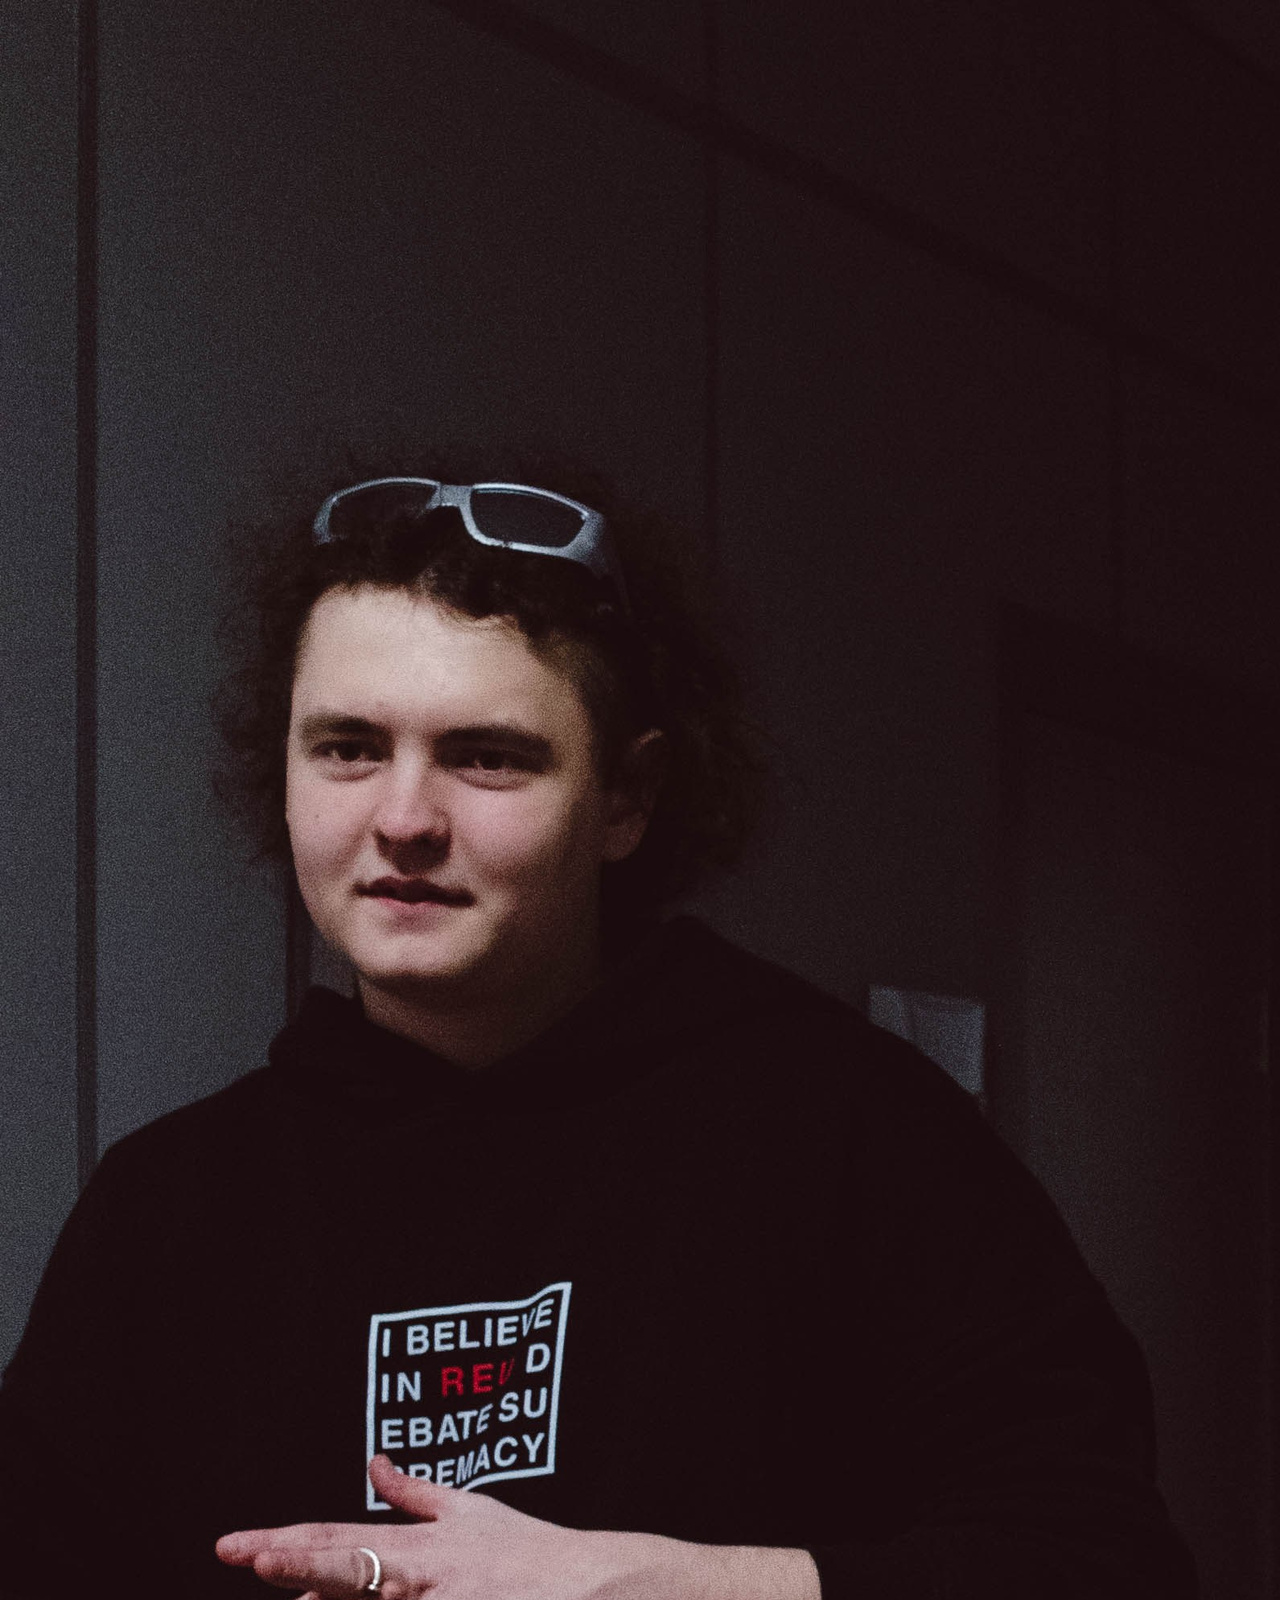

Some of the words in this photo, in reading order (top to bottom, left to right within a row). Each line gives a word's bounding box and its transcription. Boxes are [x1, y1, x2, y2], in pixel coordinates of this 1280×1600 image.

[382, 1328, 391, 1357] I
[406, 1298, 555, 1356] BELIEVE
[381, 1371, 422, 1403] IN
[526, 1342, 551, 1373] D
[381, 1403, 493, 1450] EBATE
[498, 1387, 548, 1422] SU
[392, 1432, 545, 1488] REMACY
